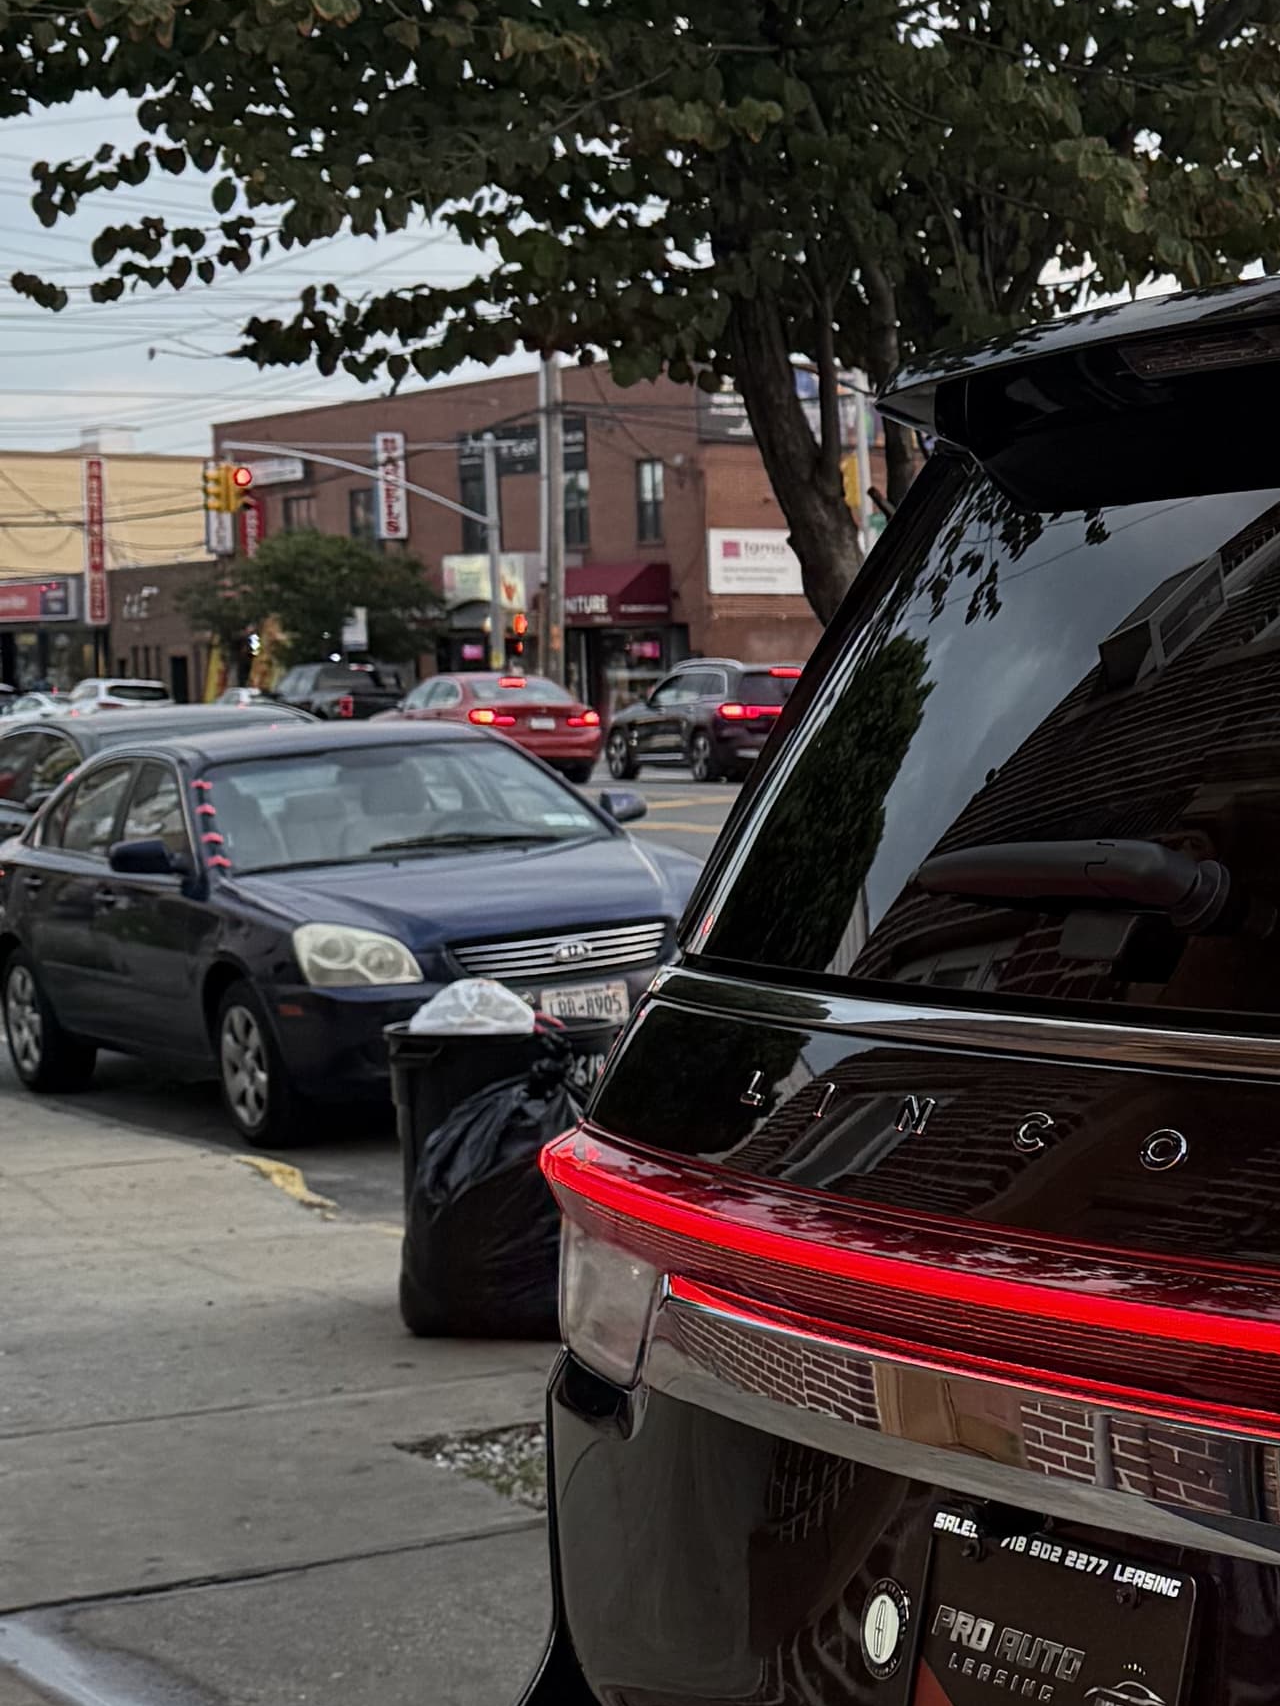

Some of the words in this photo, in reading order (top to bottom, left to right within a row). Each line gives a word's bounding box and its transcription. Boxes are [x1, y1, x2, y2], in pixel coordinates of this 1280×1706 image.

[1028, 1540, 1063, 1565] 902
[1064, 1549, 1109, 1576] 2277
[1113, 1563, 1182, 1599] LEASING
[931, 1604, 996, 1653] PRO
[995, 1626, 1086, 1683] AUTO
[948, 1652, 1055, 1703] LEASING
